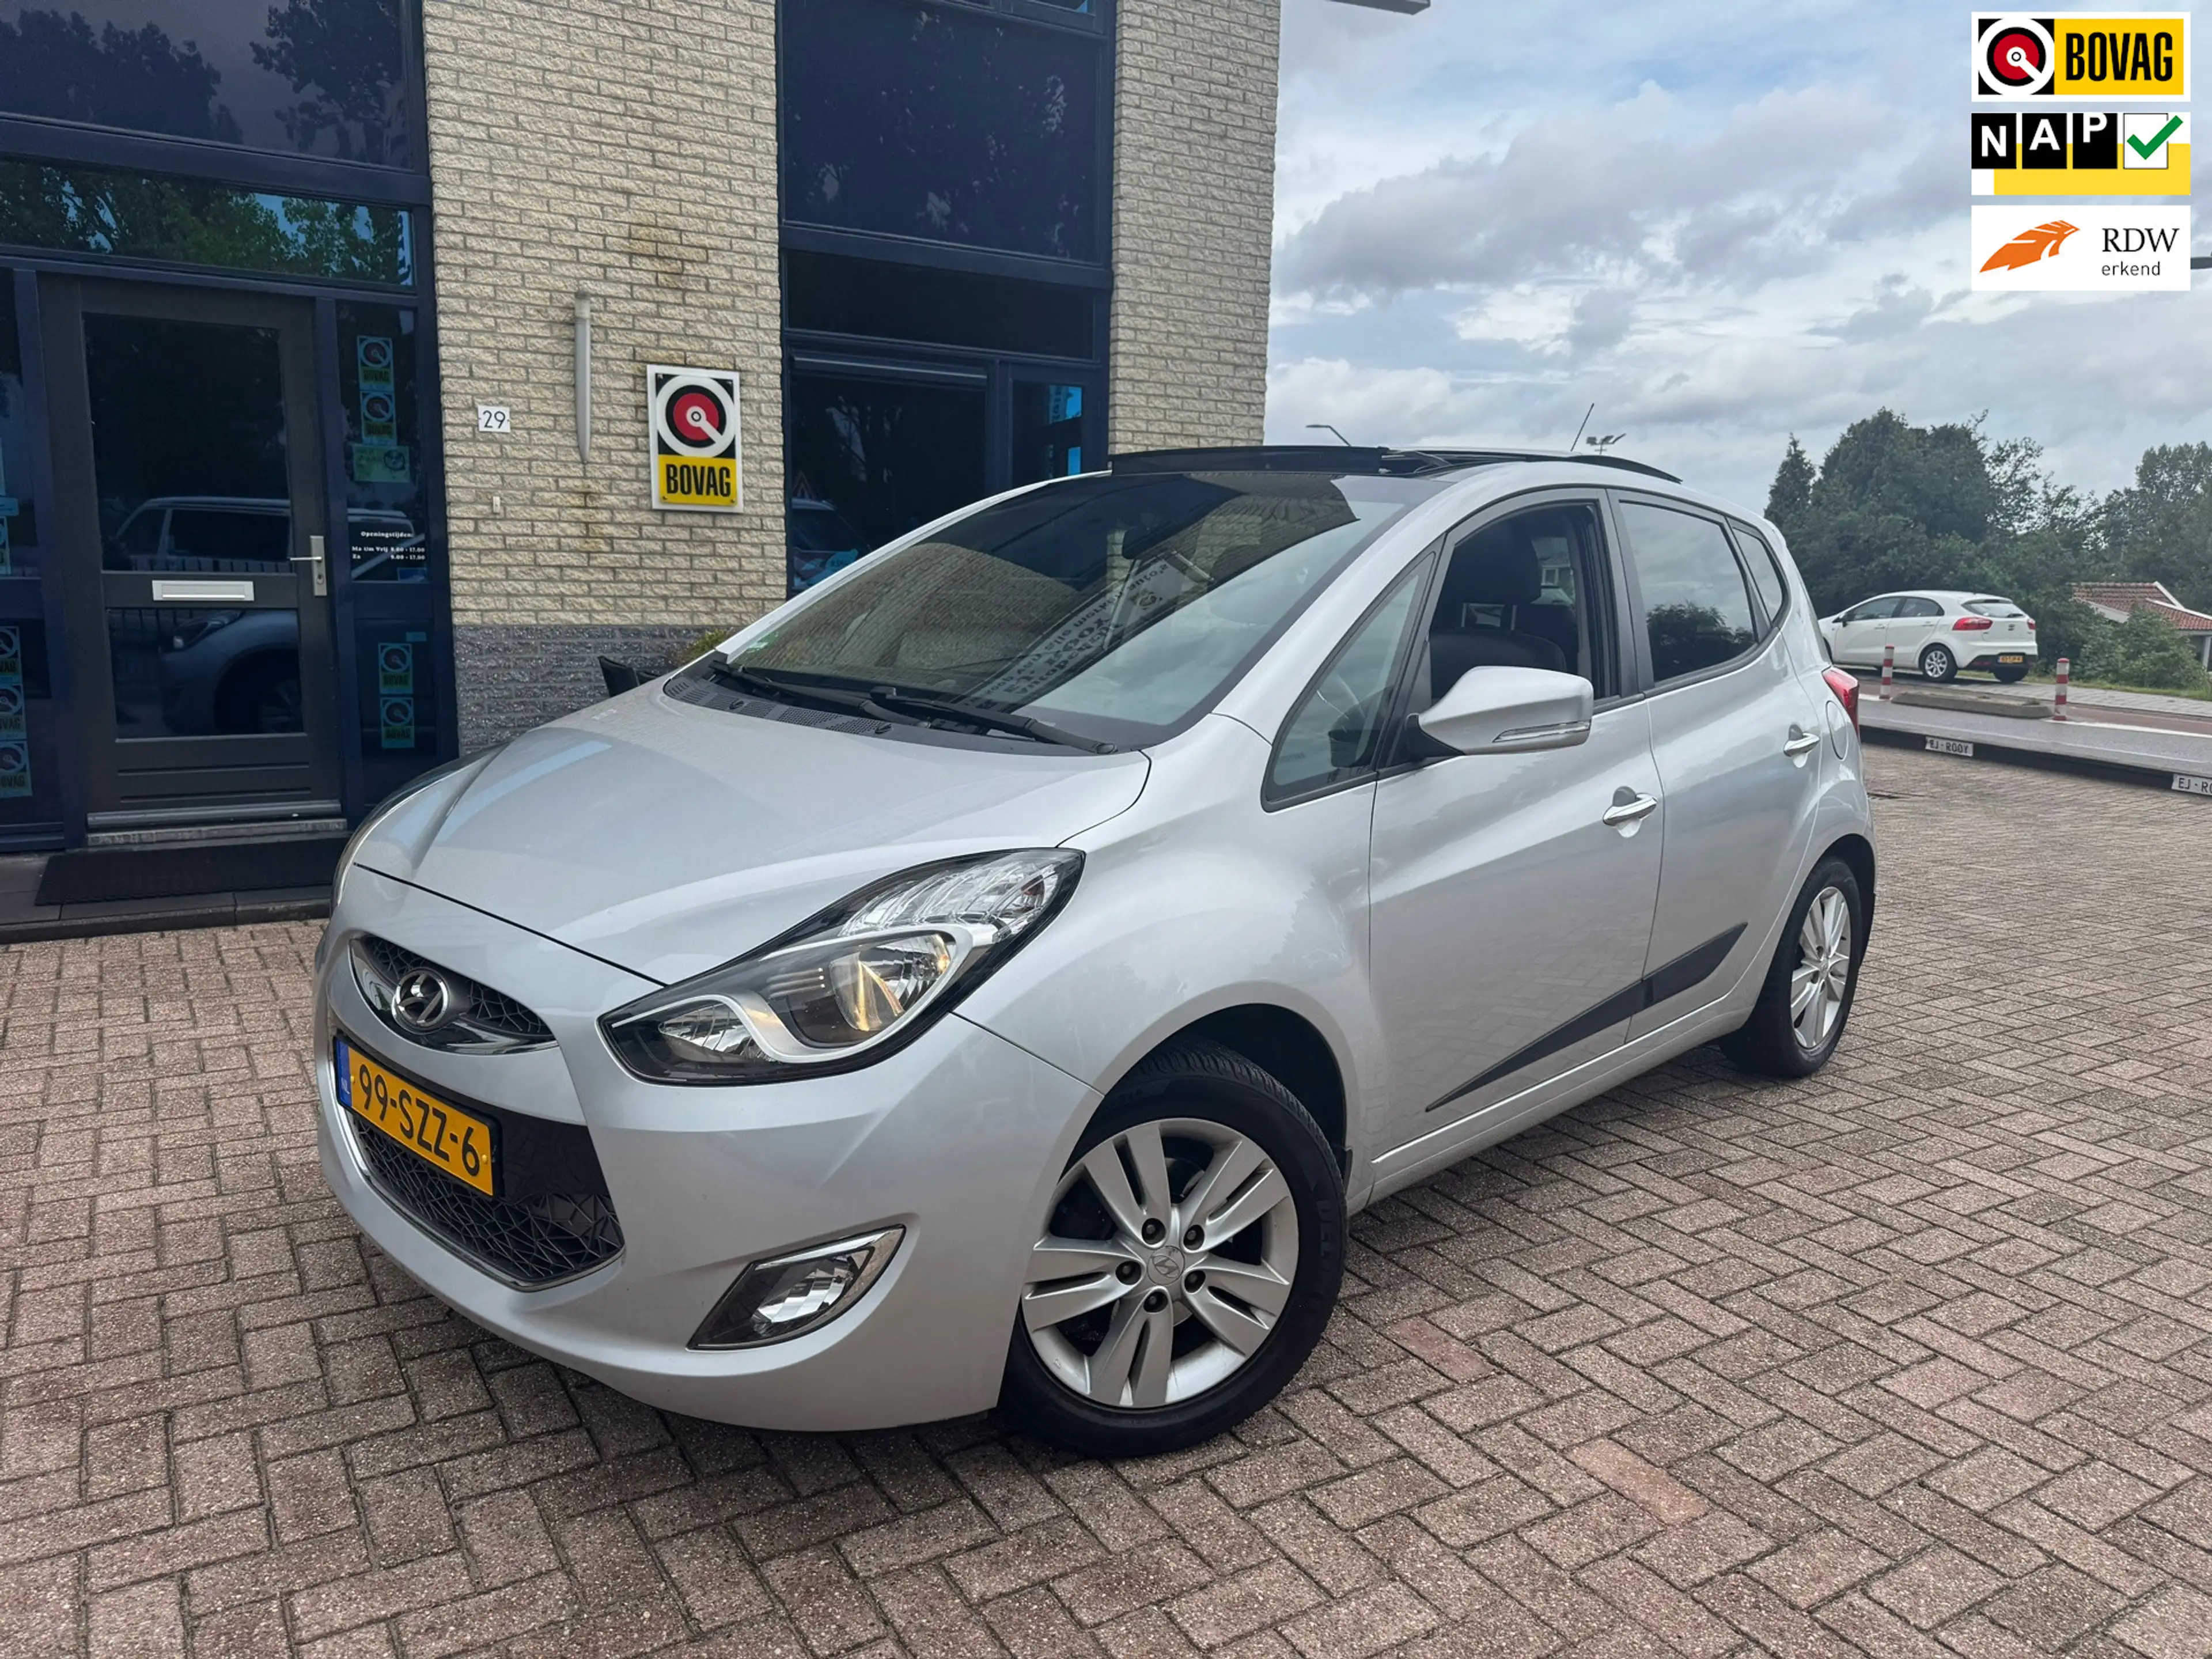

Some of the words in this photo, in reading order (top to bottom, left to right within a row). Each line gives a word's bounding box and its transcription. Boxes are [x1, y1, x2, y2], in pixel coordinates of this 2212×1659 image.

[483, 410, 506, 429] 29
[666, 464, 731, 497] BOVAG
[0, 662, 16, 673] VAG
[2179, 777, 2191, 789] EJ
[358, 1064, 480, 1177] 99-SZZ-6
